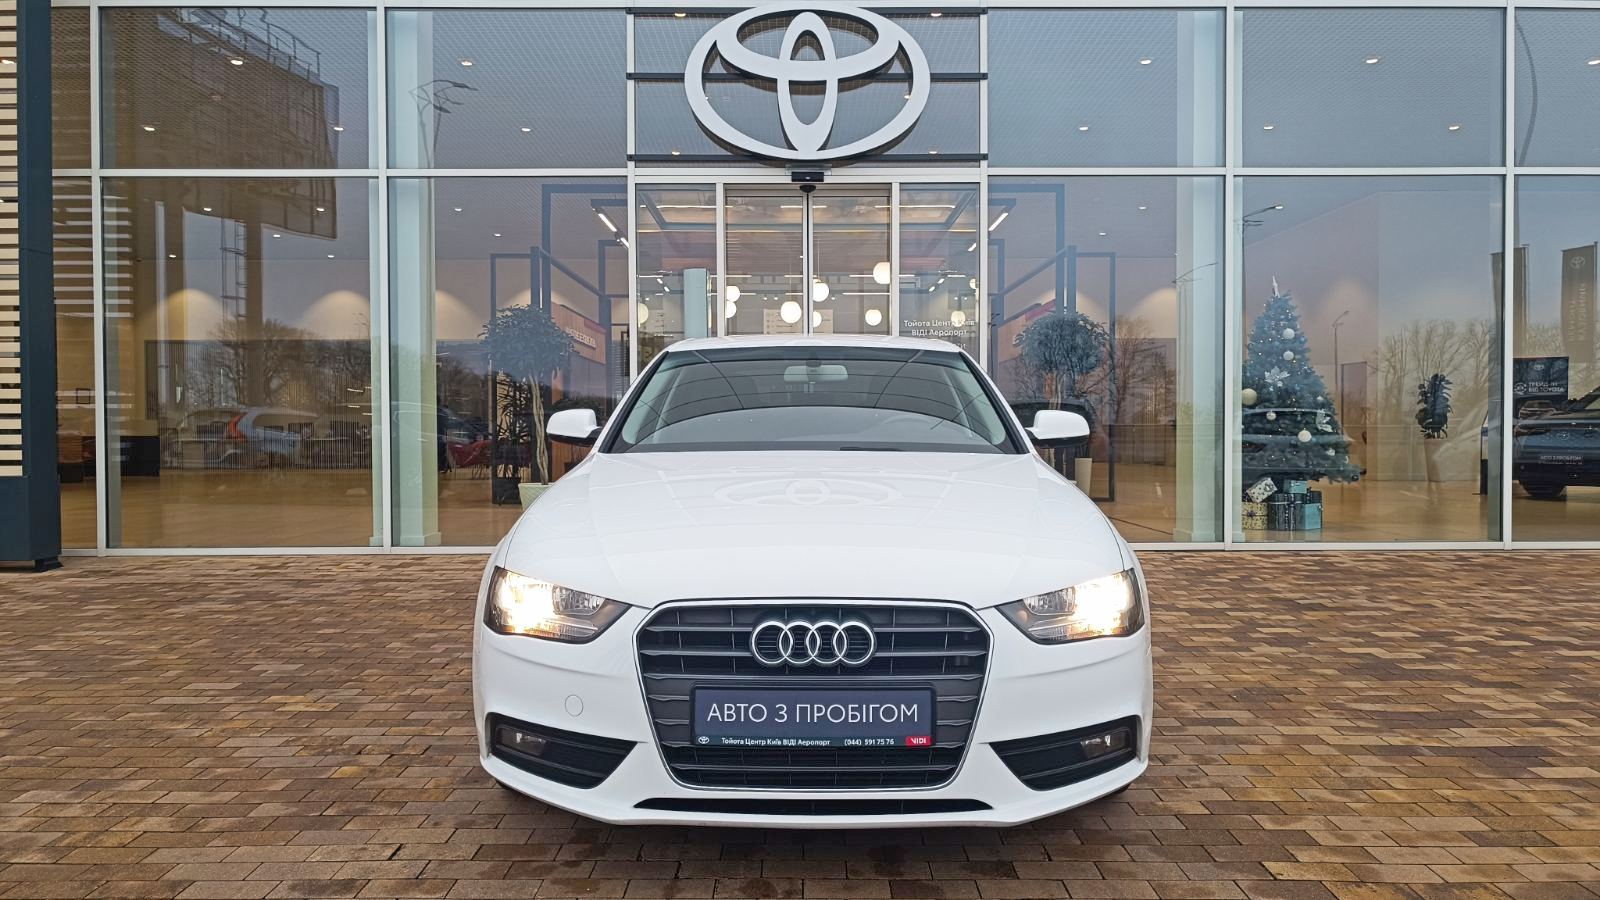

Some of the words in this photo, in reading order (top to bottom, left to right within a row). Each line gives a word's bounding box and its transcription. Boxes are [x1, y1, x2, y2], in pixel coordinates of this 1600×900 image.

[911, 329, 928, 337] ВІДІ
[929, 329, 967, 337] Аеропорт
[707, 703, 767, 722] АВТО
[774, 704, 788, 722] З
[796, 704, 918, 723] ПРОБІГОМ
[721, 737, 745, 745] Тойота
[745, 738, 767, 746] Центр
[767, 737, 782, 746] Київ
[782, 738, 797, 746] ВІДІ
[798, 738, 831, 747] Аеропорт
[844, 738, 862, 746] (044)
